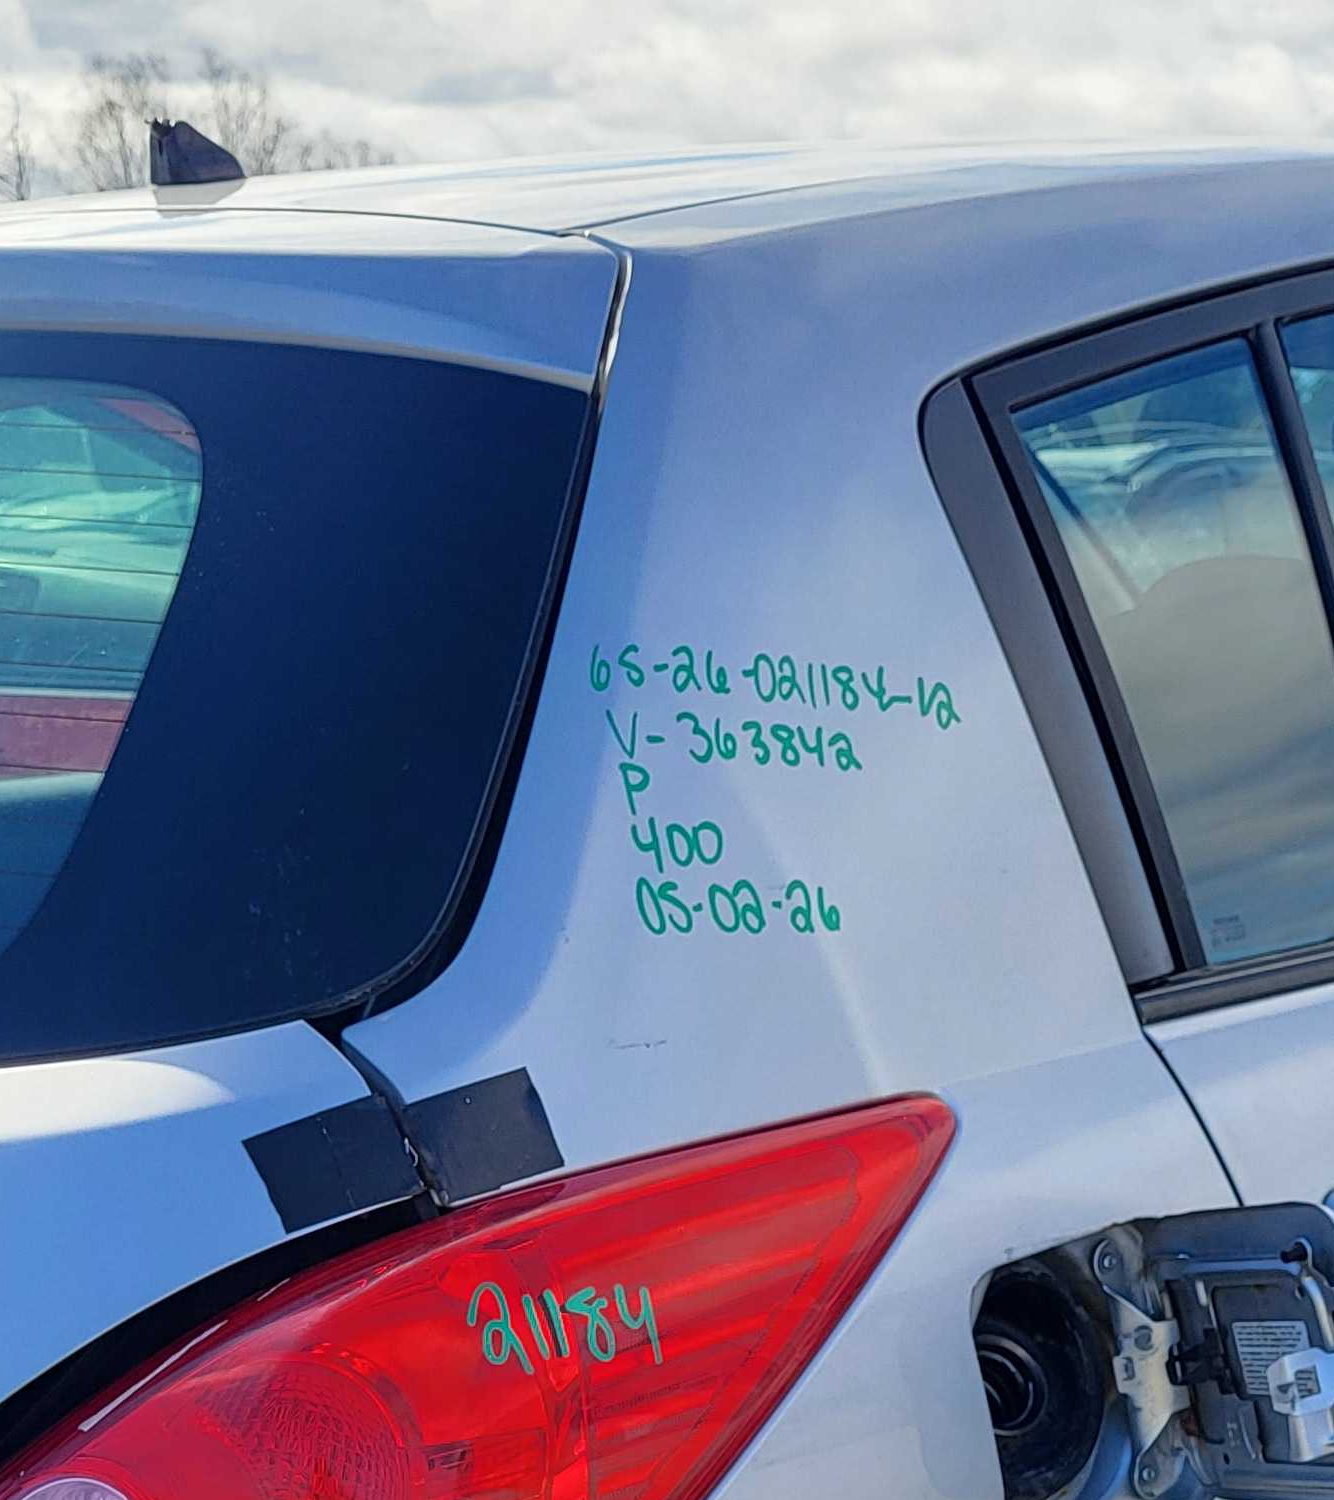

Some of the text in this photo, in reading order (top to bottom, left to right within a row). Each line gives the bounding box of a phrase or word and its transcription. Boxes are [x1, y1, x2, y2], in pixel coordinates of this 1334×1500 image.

[619, 762, 650, 815] P
[631, 816, 723, 873] 400
[636, 877, 841, 935] 05-02-26
[467, 1281, 664, 1375] 21184
